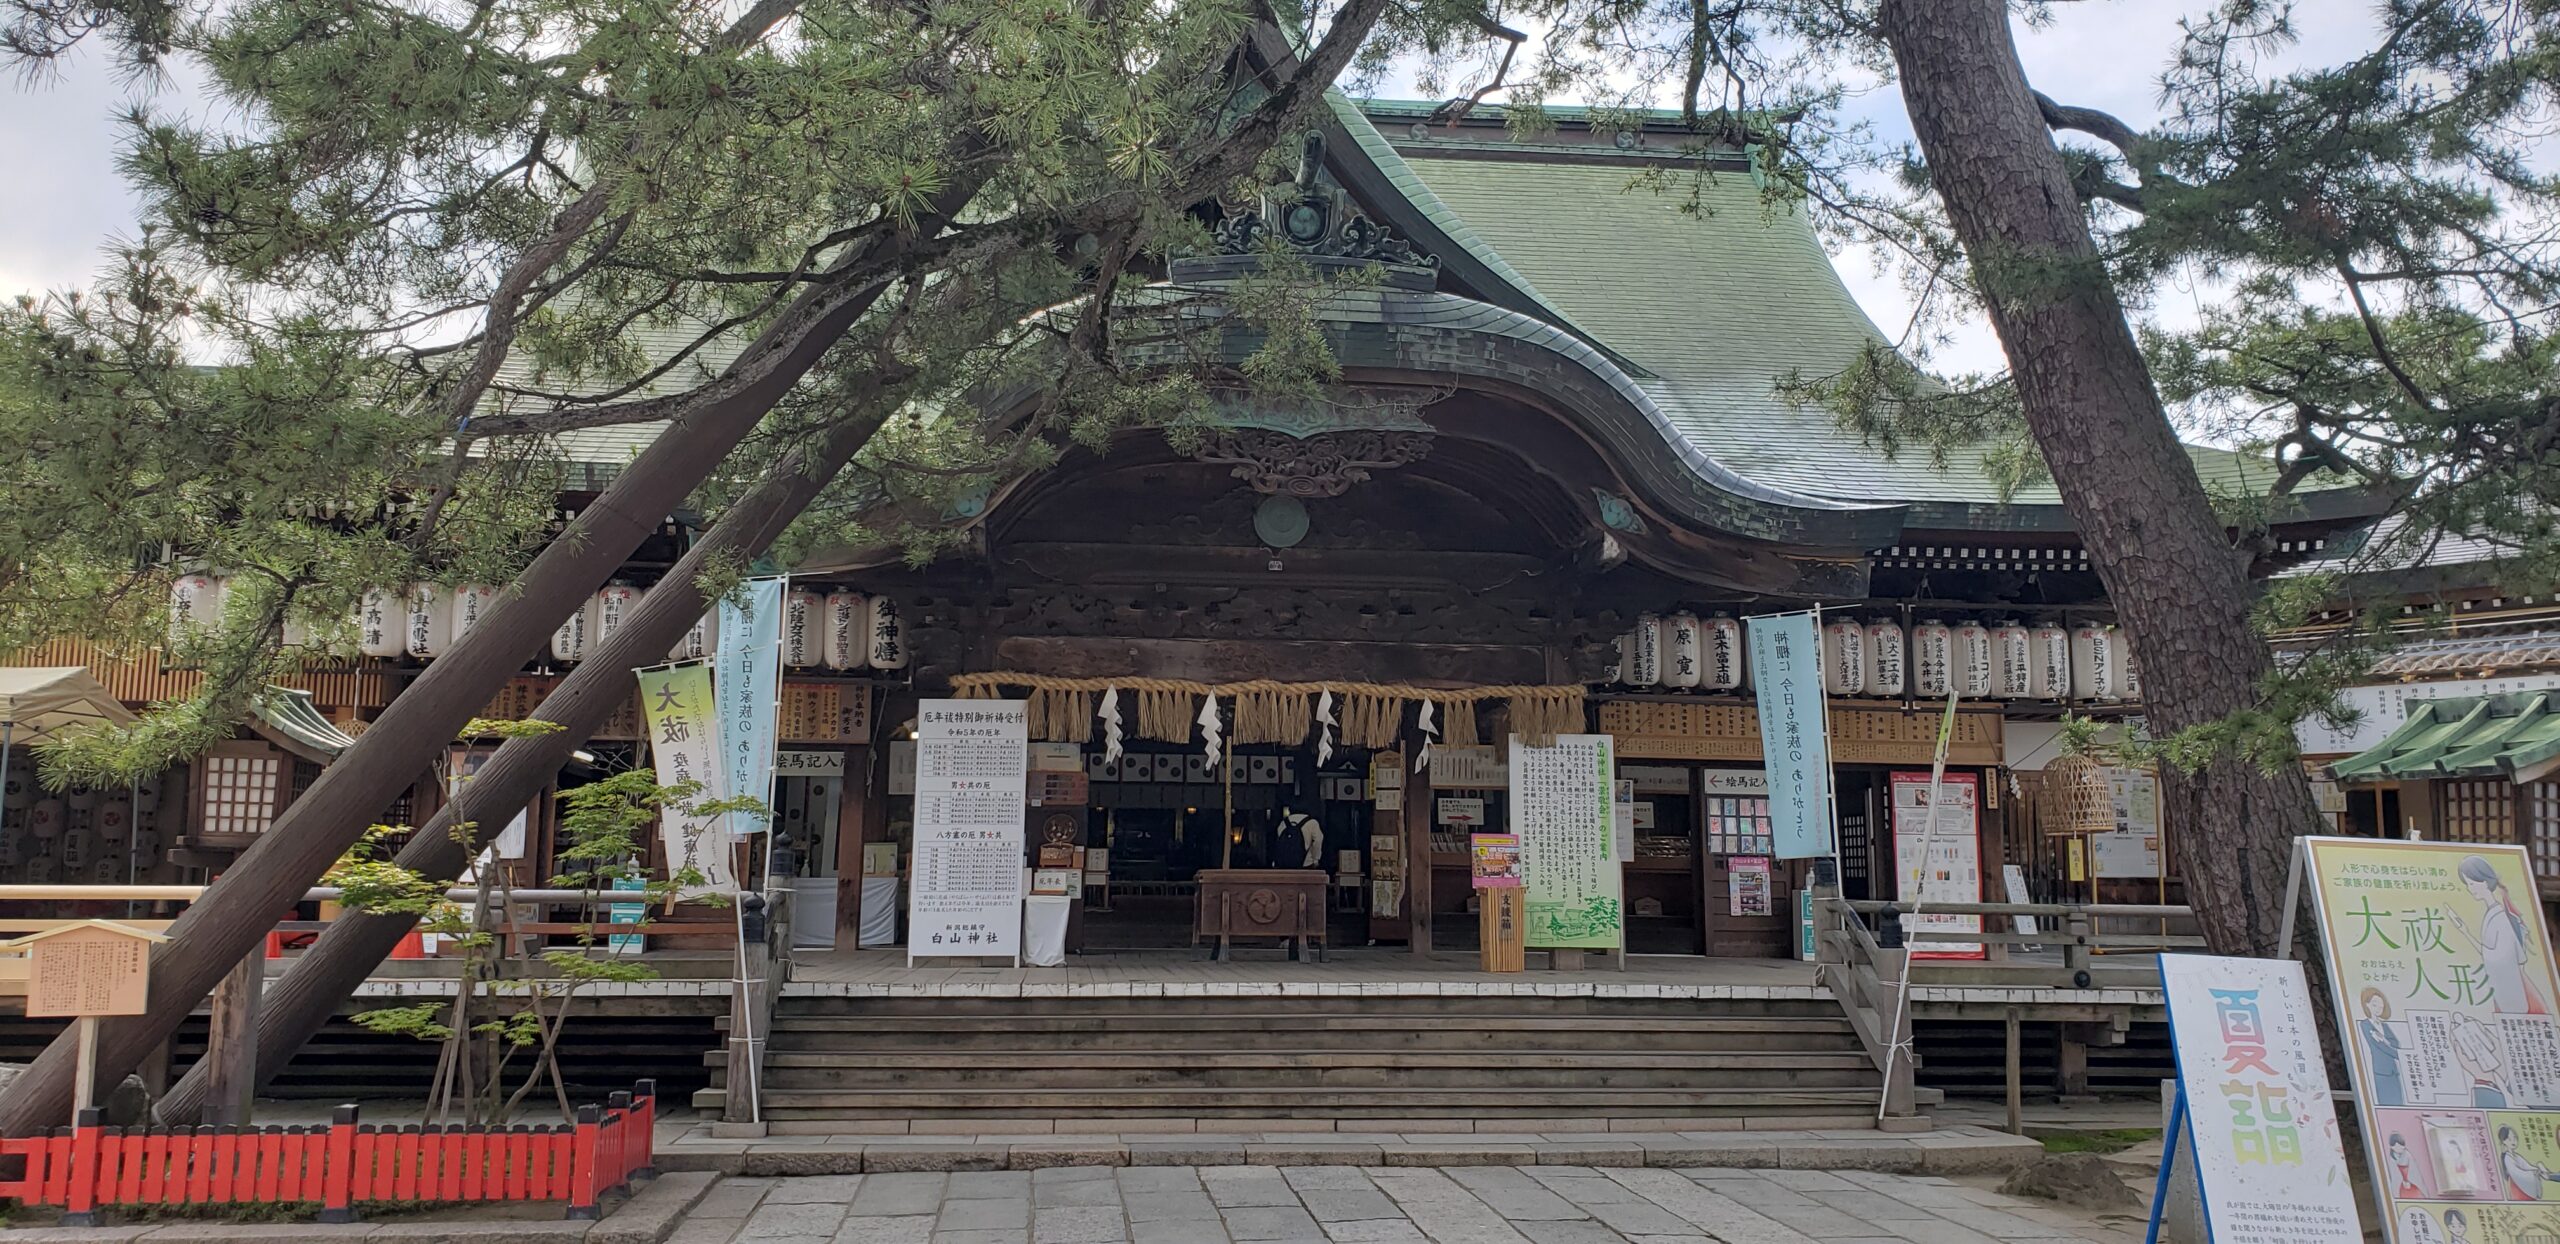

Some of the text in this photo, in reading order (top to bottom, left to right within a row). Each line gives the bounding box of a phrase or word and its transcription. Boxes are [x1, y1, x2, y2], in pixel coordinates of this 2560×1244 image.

[789, 603, 805, 665] 北陸ガス株式会社
[874, 598, 901, 662] 御神燈
[1713, 629, 1732, 685] 並木富士雄
[2093, 639, 2105, 696] BSNアイネット
[948, 728, 1001, 737] 令和5年の厄年
[951, 781, 991, 790] 男女共の厄
[979, 831, 1003, 840] 男女共
[2333, 877, 2463, 892] ご家族の健康を祈りましょう。
[2341, 863, 2448, 877] 人形で心身をはらい清め
[931, 931, 999, 945] 白山神社
[2345, 895, 2456, 954] 大祓
[2361, 959, 2406, 969] おおはらえ
[2363, 972, 2400, 982] ひとがた
[2405, 957, 2495, 1006] 人形
[2278, 975, 2308, 1075] 新しい日本の風習
[2423, 1016, 2442, 1079] リフレッシュした心と
[2413, 1054, 2424, 1087] どなたでも
[2542, 1021, 2560, 1079] 大祓人形とは
[2207, 987, 2303, 1167] 夏詣
